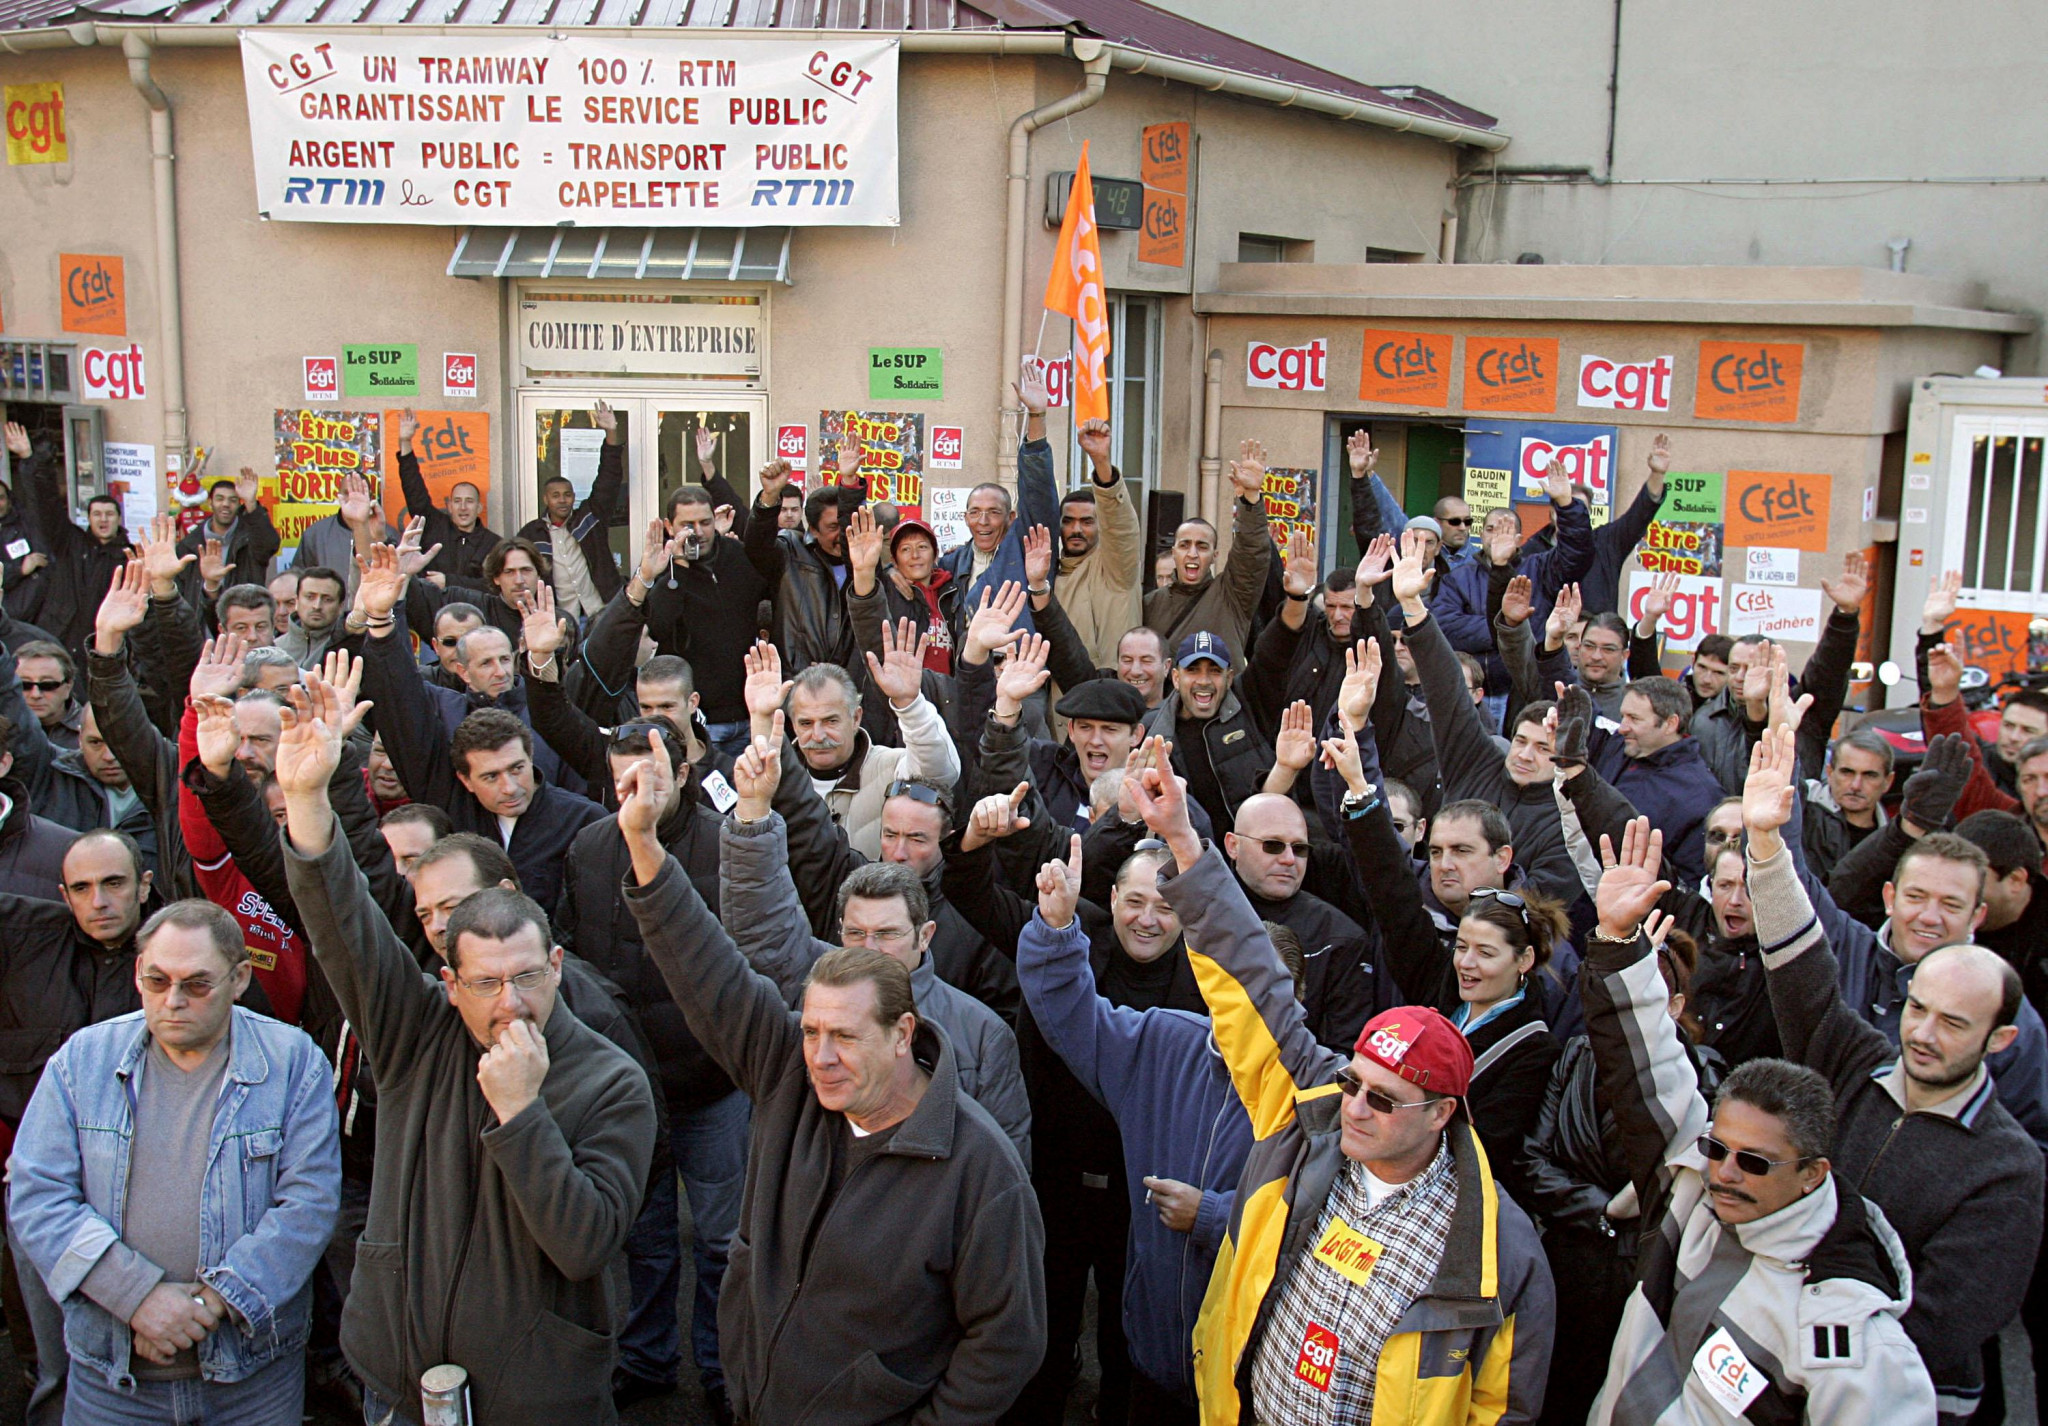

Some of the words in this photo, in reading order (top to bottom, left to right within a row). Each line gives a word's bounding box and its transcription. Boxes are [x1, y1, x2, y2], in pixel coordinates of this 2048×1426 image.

[268, 42, 335, 89] CGT
[363, 56, 397, 84] UN
[419, 56, 551, 85] TRAMWAY
[679, 58, 737, 87] RTM
[806, 49, 874, 99] CGT
[300, 92, 506, 123] GARANTISSANT
[528, 95, 561, 123] LE
[583, 97, 699, 125] SERVICE
[729, 98, 828, 126] PUBLIC
[6, 91, 66, 154] cgt
[288, 140, 395, 168] ARGENT
[422, 142, 521, 170] PUBLIC
[543, 150, 553, 166] =
[567, 142, 727, 171] TRANSPORT
[755, 143, 849, 171] PUBLIC
[453, 179, 512, 208] CGT
[558, 179, 719, 209] CAPELETTE
[1107, 187, 1130, 215] 48
[1146, 199, 1179, 240] Cfdt
[67, 261, 115, 308] Cfdt
[529, 321, 604, 351] COMITE
[346, 350, 367, 365] Le
[369, 350, 402, 365] SUP
[873, 353, 892, 368] Le
[894, 354, 928, 369] SUP
[1249, 341, 1326, 391] cgt
[1373, 338, 1438, 379] Cfdt
[1476, 343, 1544, 387] Cfdt
[84, 343, 145, 399] cgt
[308, 368, 334, 387] cgt
[369, 372, 416, 387] Solidaires
[447, 365, 474, 384] cgt
[893, 375, 940, 390] Solidaires
[1711, 349, 1785, 394] Cfdt
[311, 391, 333, 399] RTM
[449, 388, 471, 396] RTM
[1582, 357, 1670, 411] cgt
[300, 411, 354, 441] Être
[293, 445, 357, 467] Plus
[779, 437, 805, 454] cgt
[934, 438, 960, 455] cgt
[120, 458, 151, 468] COLLECTIVE
[120, 468, 143, 477] GAGNER
[936, 460, 957, 468] RTM
[1470, 469, 1506, 481] GAUDIN
[1522, 440, 1607, 489] cgt
[1467, 489, 1479, 497] TON
[1477, 481, 1498, 490] RETIRE
[1674, 478, 1706, 492] SUP
[933, 490, 957, 505] Cfdt
[1264, 497, 1297, 517] lus
[1673, 498, 1716, 513] Solidaires
[1739, 479, 1814, 523] Cfdt
[942, 511, 948, 521] NE
[1648, 522, 1697, 550] Être
[1640, 553, 1699, 575] Plus
[1749, 549, 1773, 564] Cfdt
[1630, 585, 1720, 640] cgt
[1735, 589, 1774, 612] Cfdt
[1757, 614, 1815, 635] j'adhère
[1370, 1030, 1410, 1061] cgt
[1303, 1340, 1334, 1368] cgt
[1299, 1360, 1327, 1386] RTM
[1708, 1343, 1750, 1394] Cfdt
